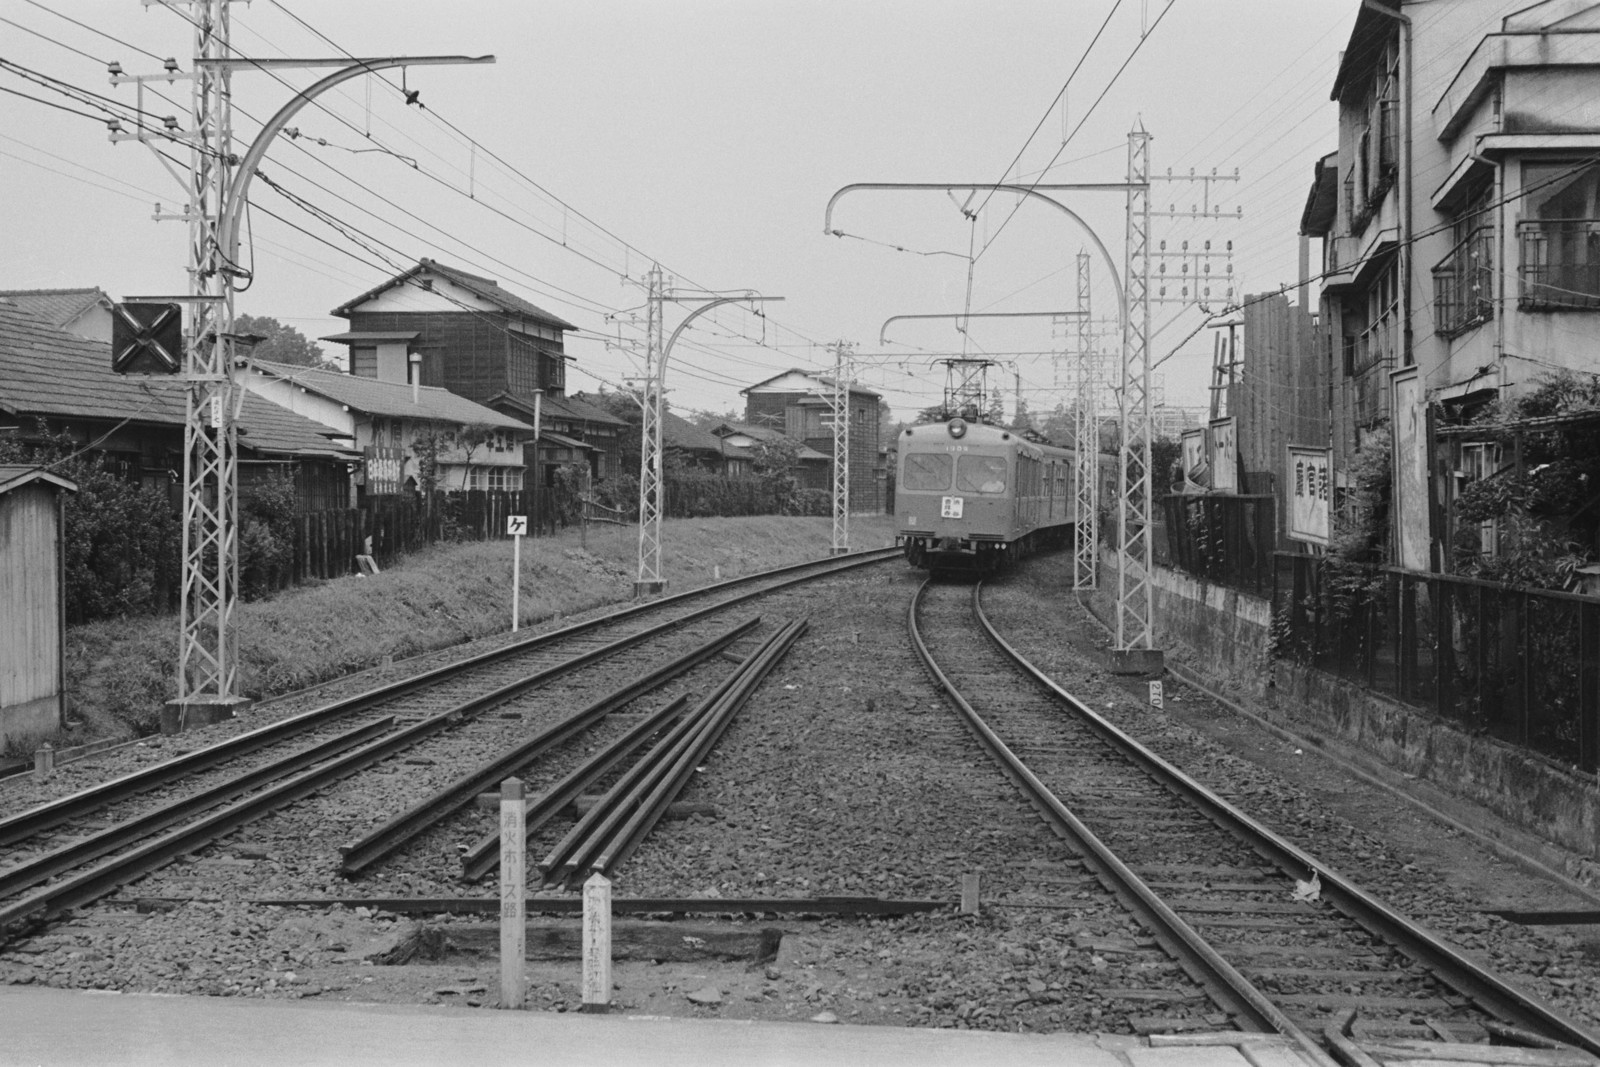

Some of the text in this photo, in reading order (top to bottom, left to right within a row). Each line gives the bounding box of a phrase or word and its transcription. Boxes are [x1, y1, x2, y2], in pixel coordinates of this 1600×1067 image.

[509, 517, 525, 533] ケ
[503, 811, 518, 919] 消火ホース路
